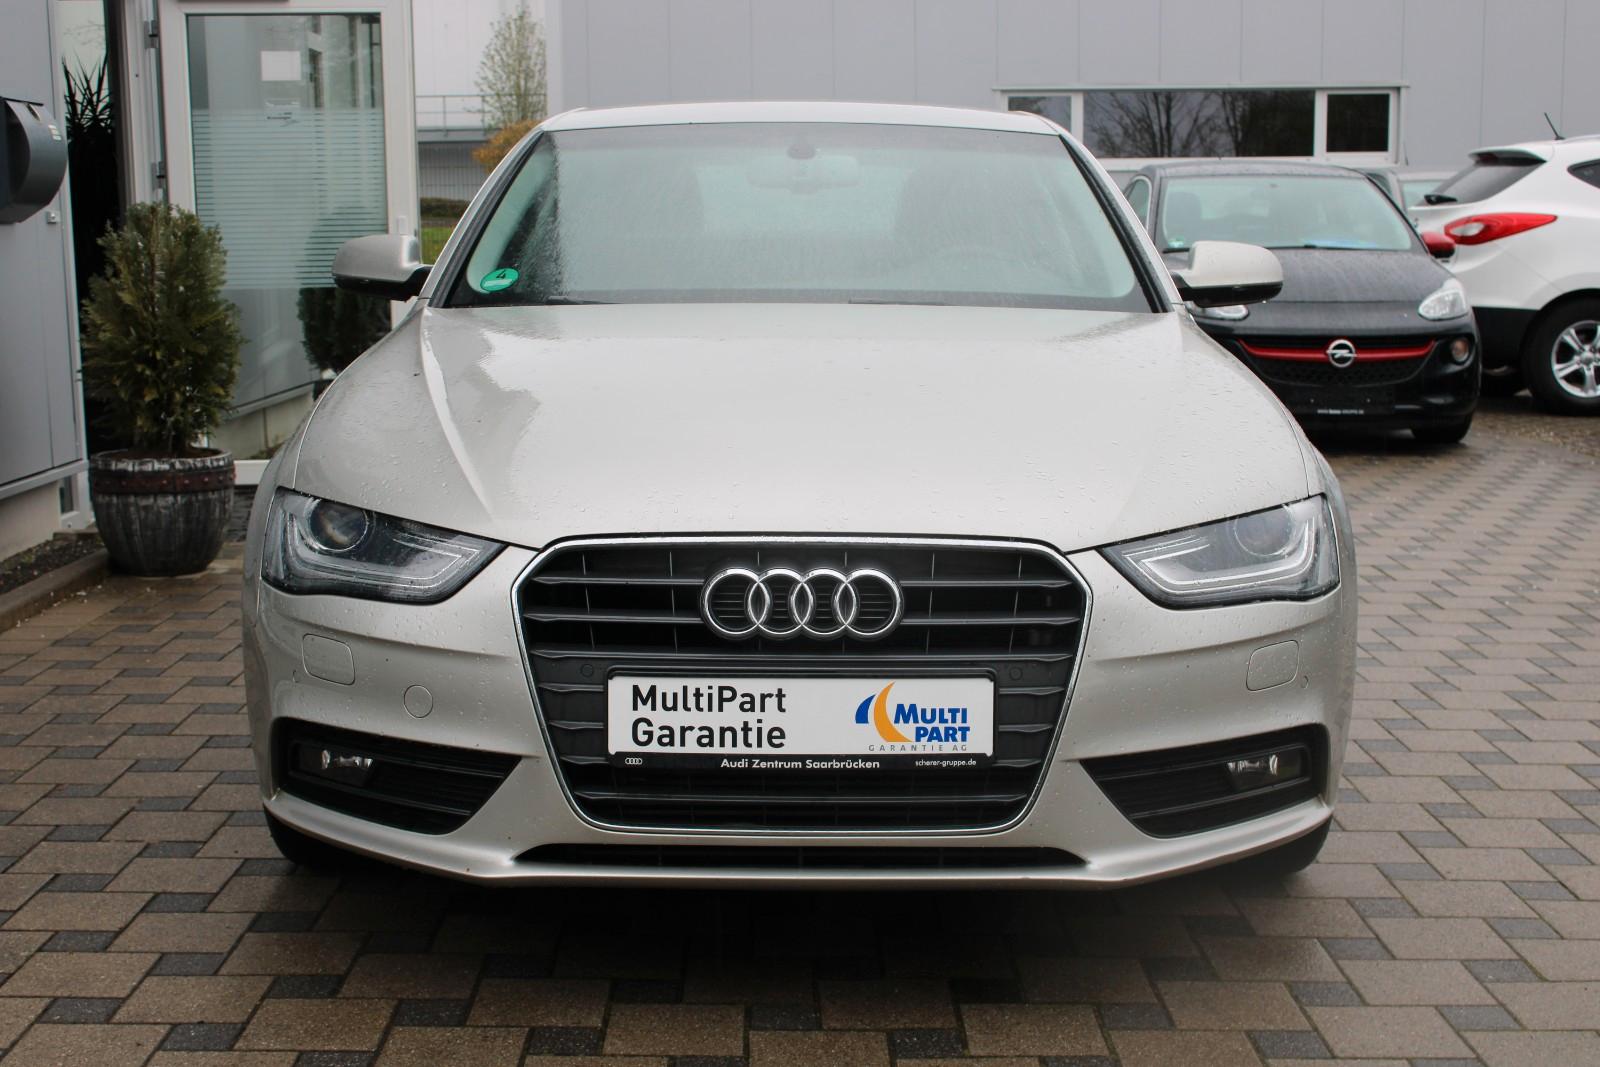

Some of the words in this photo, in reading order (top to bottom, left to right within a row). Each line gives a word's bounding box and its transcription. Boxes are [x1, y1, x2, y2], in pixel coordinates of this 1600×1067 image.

[632, 685, 786, 713] MultiPart
[894, 703, 968, 724] MULTI
[631, 717, 786, 748] Garantie
[915, 726, 971, 742] PART
[868, 744, 944, 752] GARANTIE
[952, 744, 967, 752] AG
[720, 758, 749, 769] Audi
[752, 759, 802, 769] Zentrum
[805, 759, 880, 769] Saarbrücken
[915, 758, 977, 767] scherer-gruppe.de
